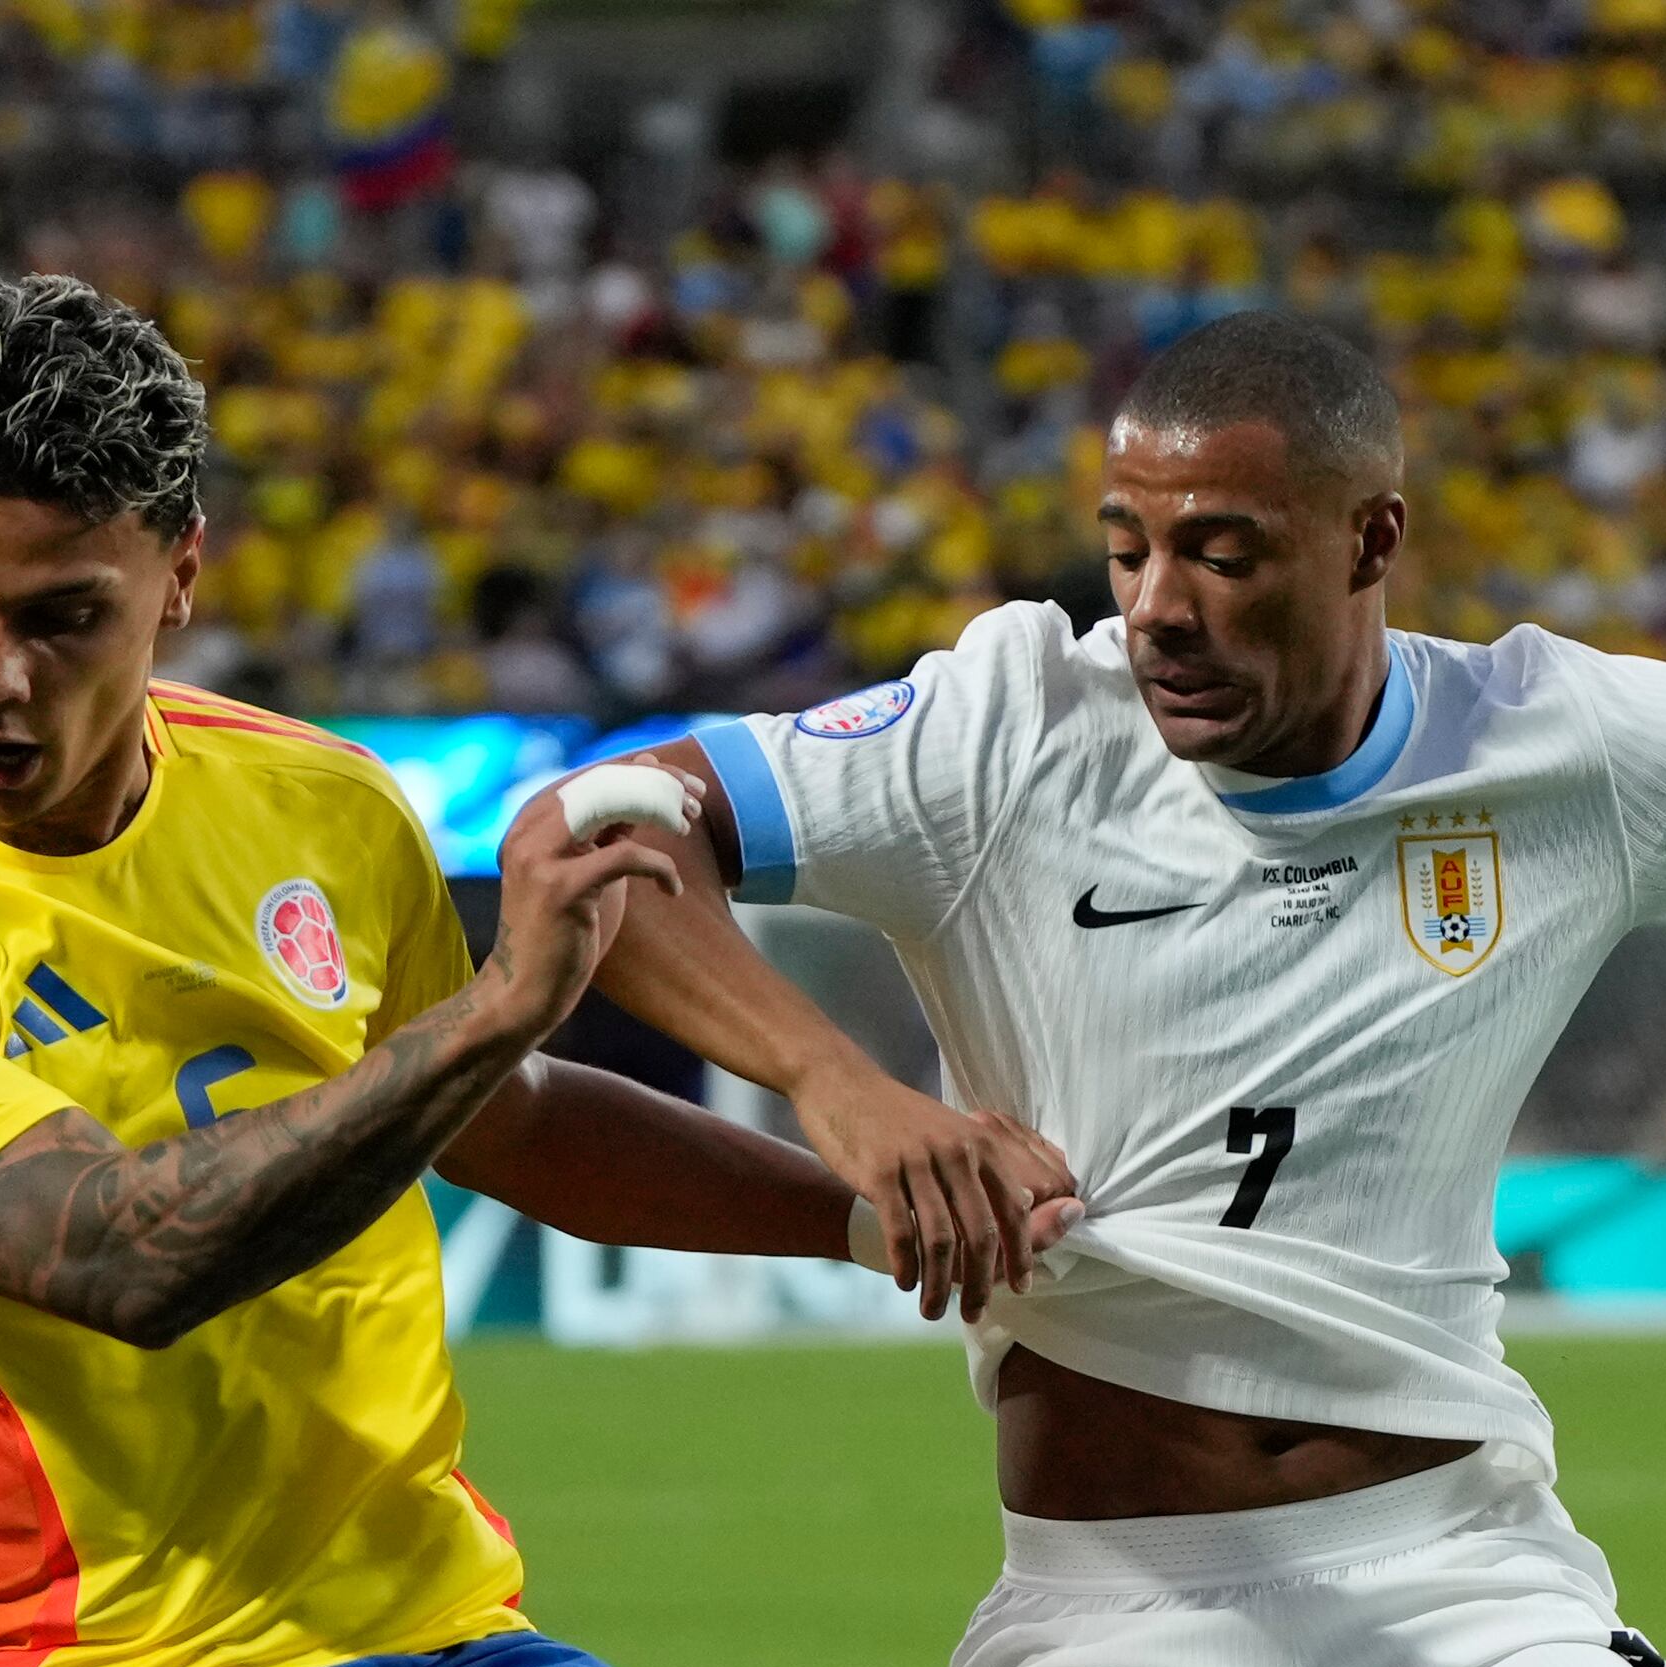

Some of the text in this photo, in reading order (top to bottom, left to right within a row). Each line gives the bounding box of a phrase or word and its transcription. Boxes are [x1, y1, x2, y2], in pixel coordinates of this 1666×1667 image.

[1262, 856, 1358, 884] VS. COLOMBIA
[1441, 860, 1464, 908] AUF
[1326, 906, 1340, 920] NC
[1218, 1106, 1296, 1230] 7
